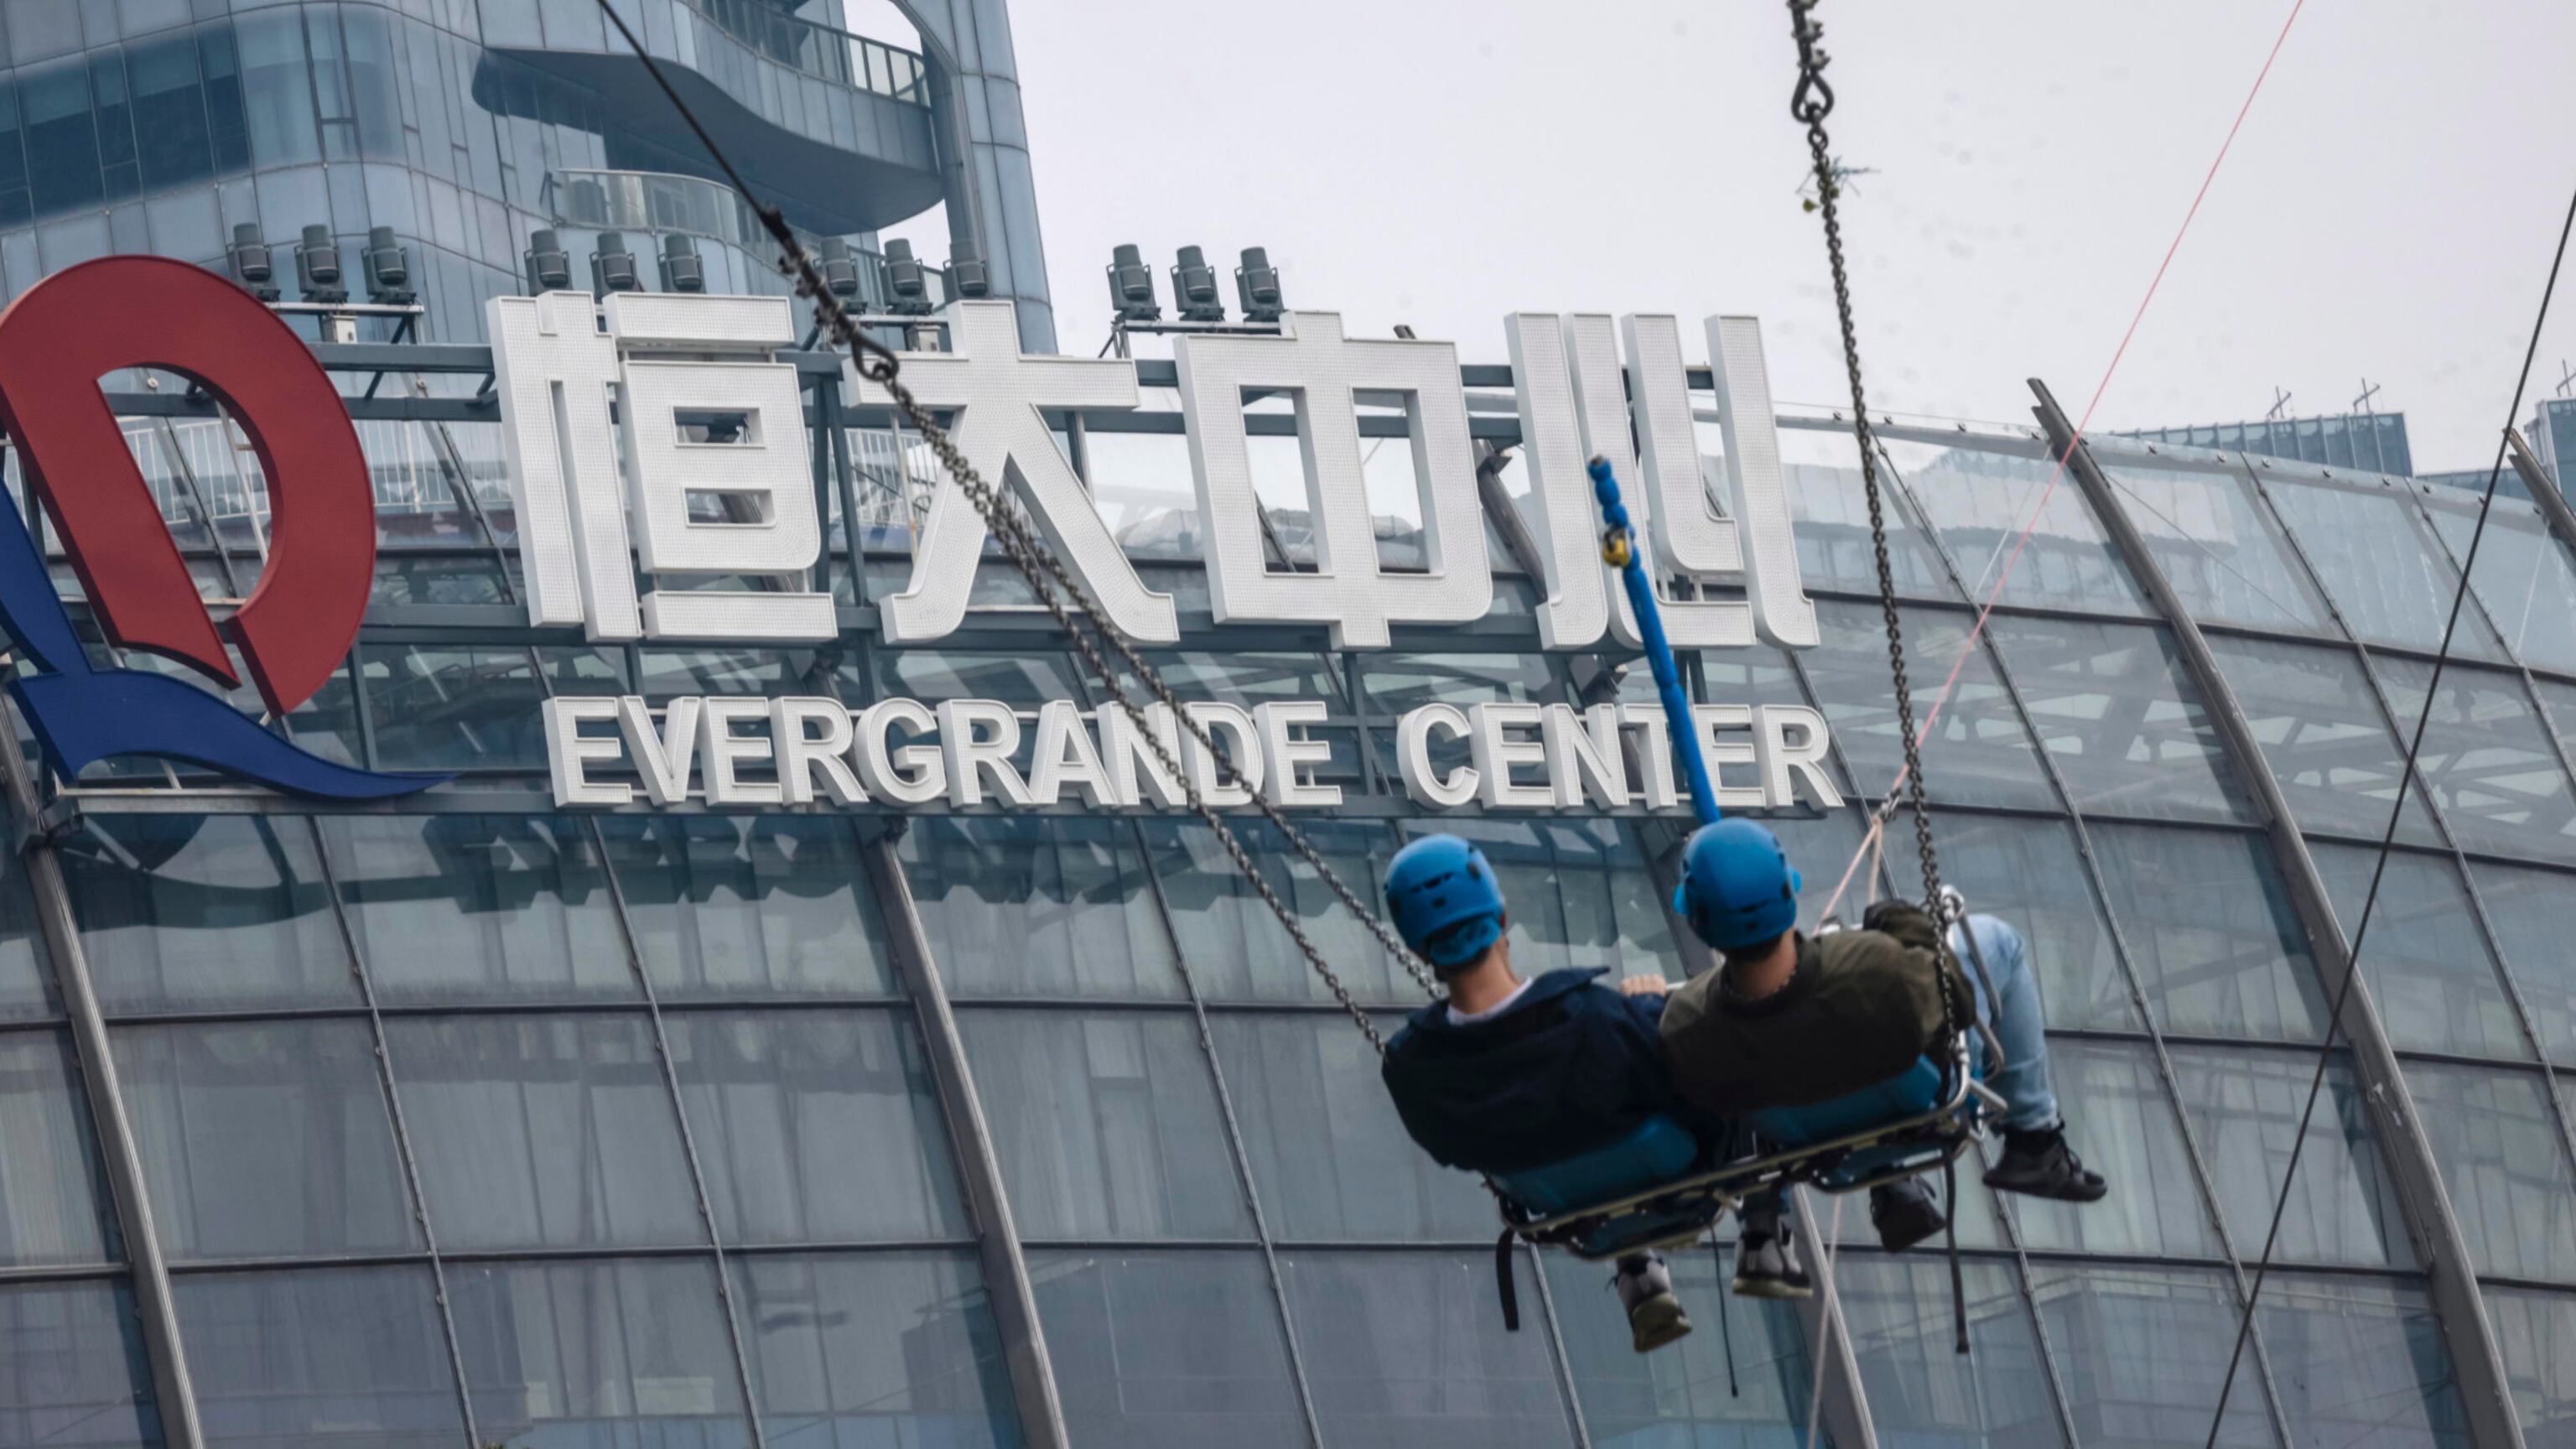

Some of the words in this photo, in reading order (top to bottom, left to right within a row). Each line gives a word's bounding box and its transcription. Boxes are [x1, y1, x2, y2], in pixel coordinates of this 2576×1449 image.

[487, 290, 1820, 651] 恒大中心
[543, 696, 1343, 810] EVERGRANDE
[1396, 702, 1845, 813] CENTER
